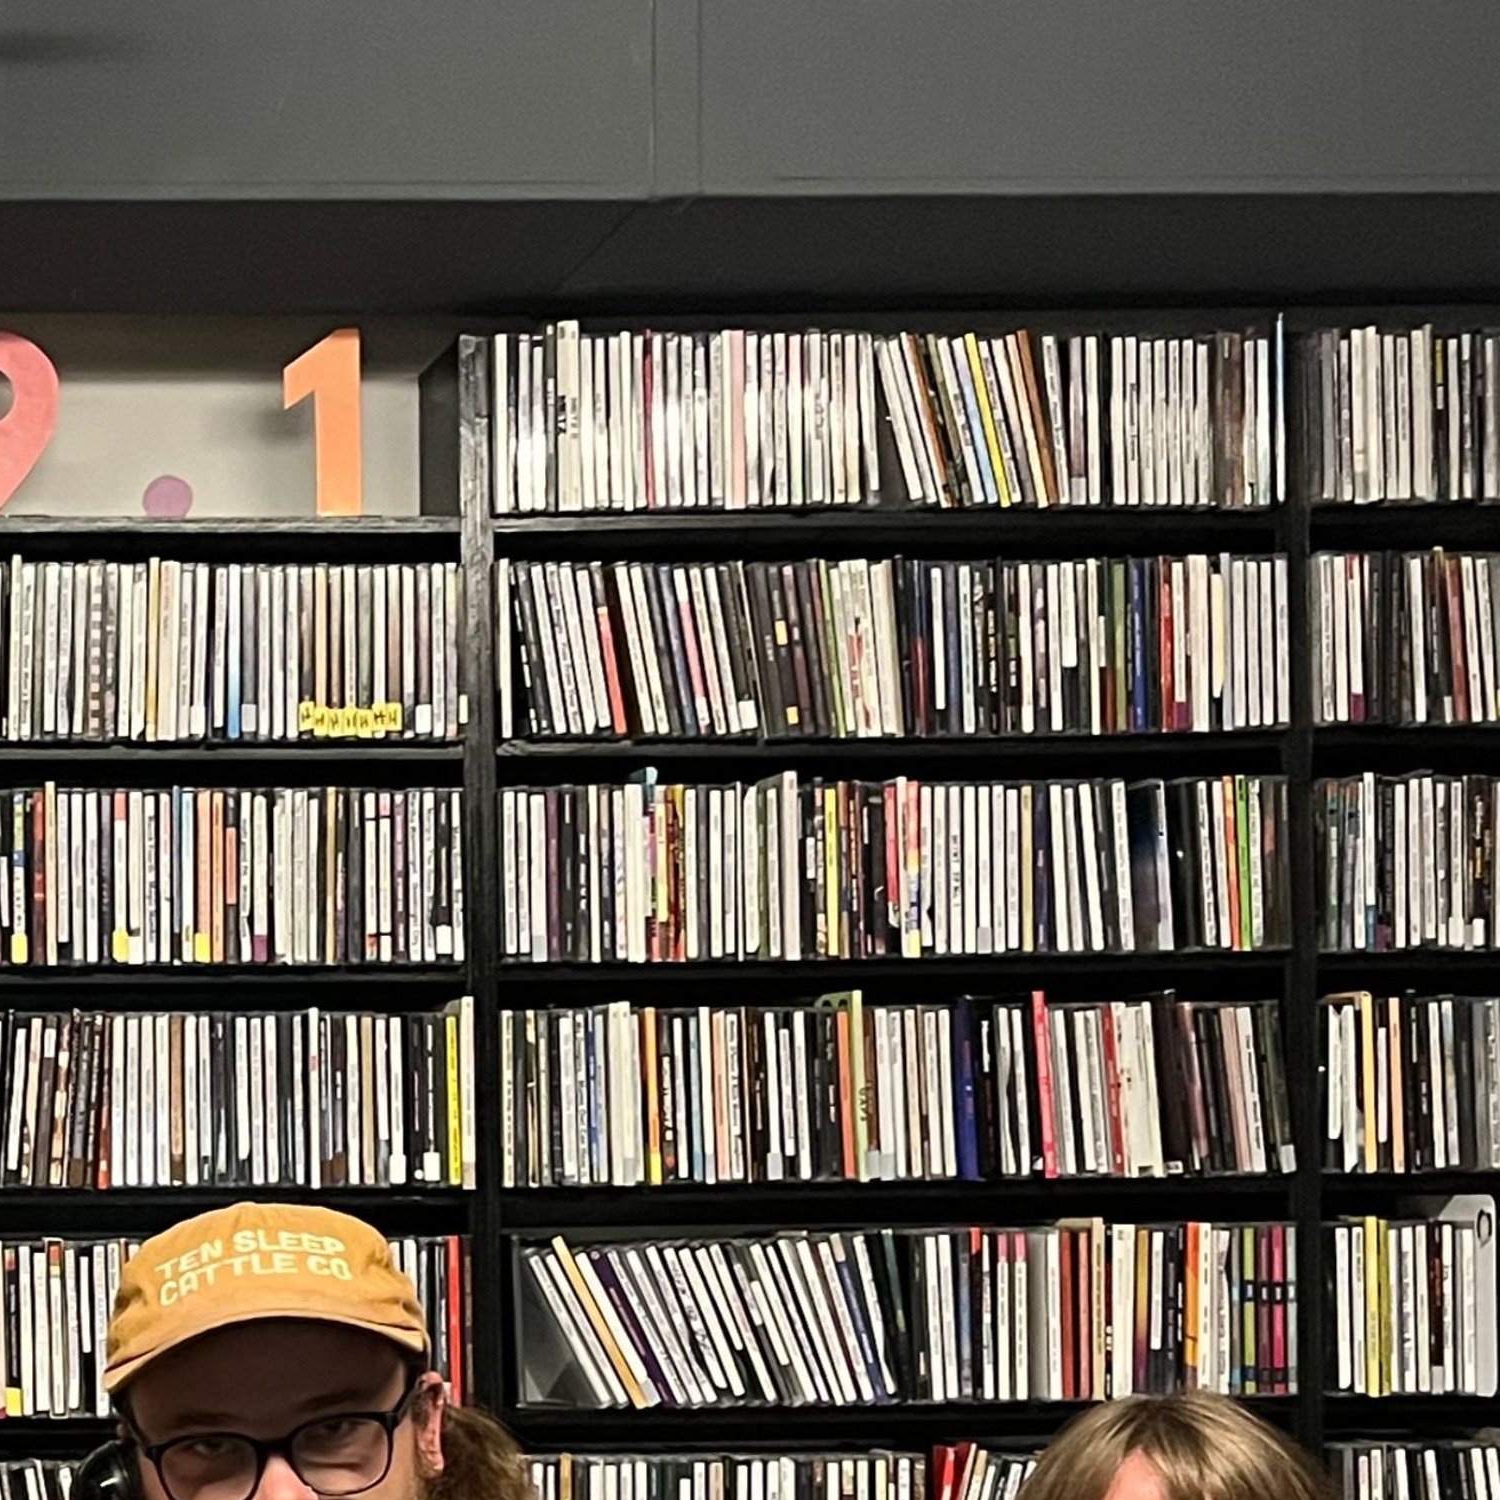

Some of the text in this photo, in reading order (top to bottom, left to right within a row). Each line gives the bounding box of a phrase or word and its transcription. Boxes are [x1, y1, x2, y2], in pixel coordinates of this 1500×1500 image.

[154, 1229, 347, 1281] TEN SLEEP
[159, 1253, 298, 1308] CATTLE
